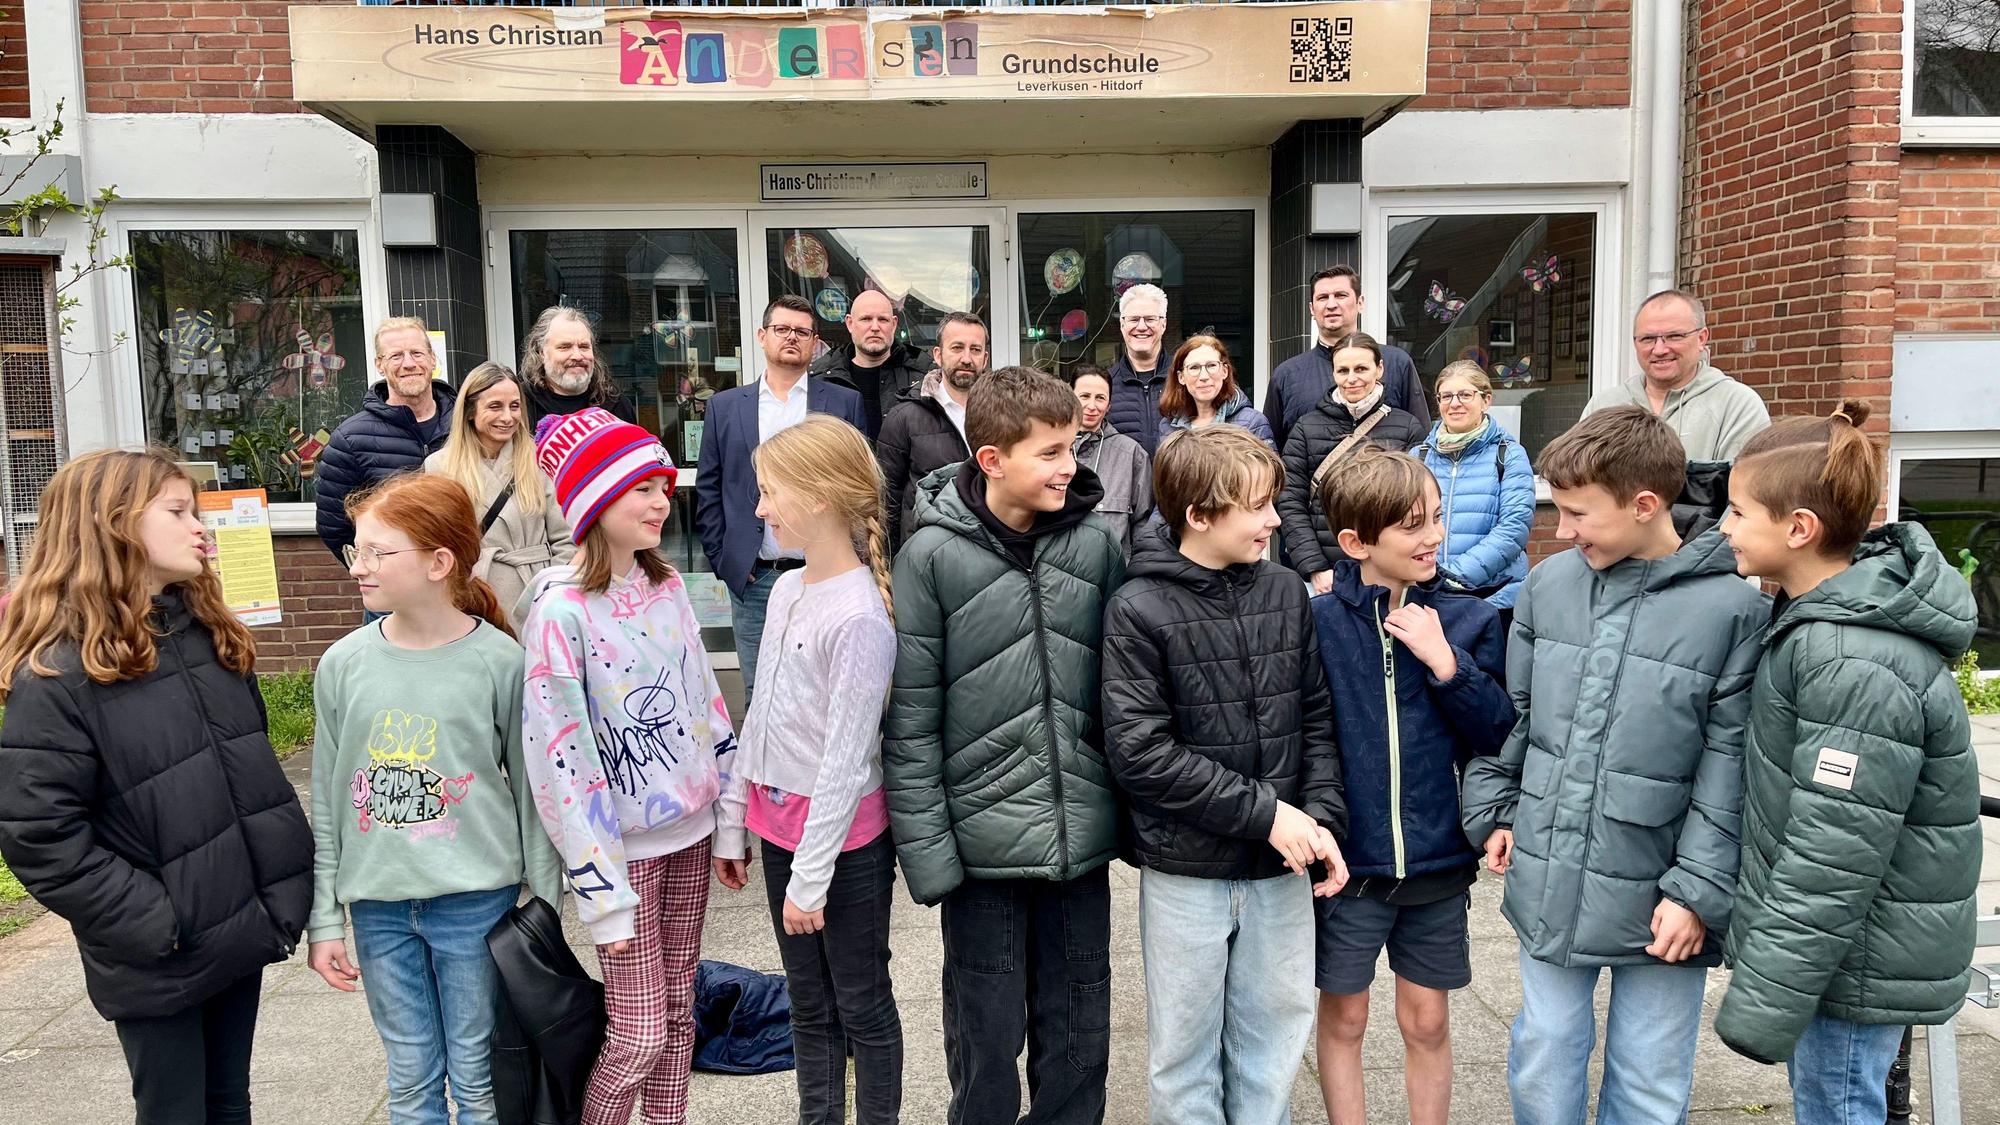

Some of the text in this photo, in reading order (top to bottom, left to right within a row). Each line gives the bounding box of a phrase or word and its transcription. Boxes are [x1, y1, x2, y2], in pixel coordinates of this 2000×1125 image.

[415, 23, 603, 46] Hans Christian
[1002, 53, 1159, 74] Grundschule
[1017, 81, 1089, 92] Leverkusen
[1100, 79, 1144, 91] Hitdorf
[541, 411, 617, 480] MONHEIM
